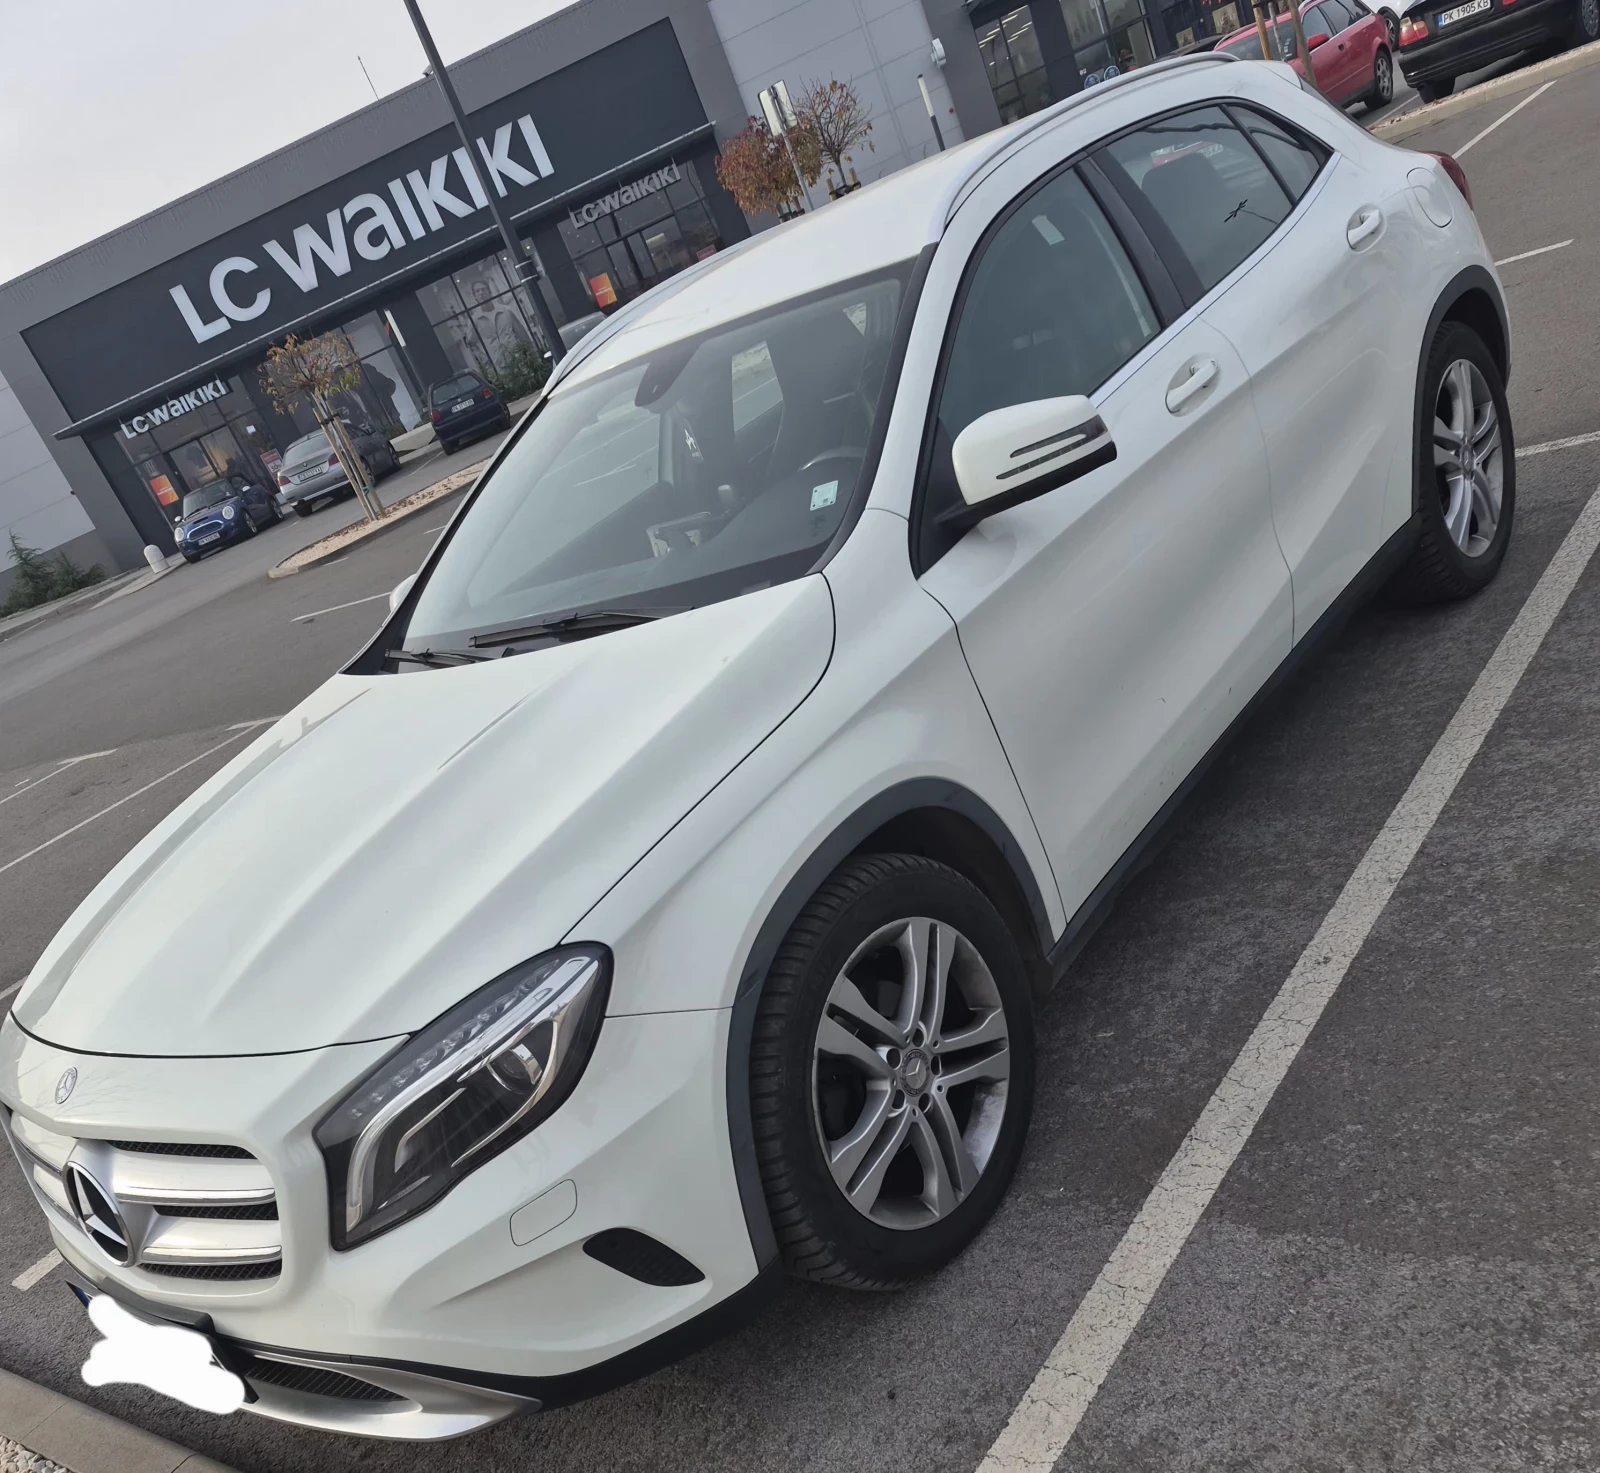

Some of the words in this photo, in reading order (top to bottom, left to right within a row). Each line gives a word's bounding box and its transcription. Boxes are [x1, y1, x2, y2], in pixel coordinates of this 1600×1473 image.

[1443, 11, 1455, 23] PK
[1456, 3, 1476, 17] 1905
[1477, 0, 1489, 8] KB
[569, 203, 598, 229] LC
[169, 256, 271, 343] LC
[121, 416, 149, 439] LC
